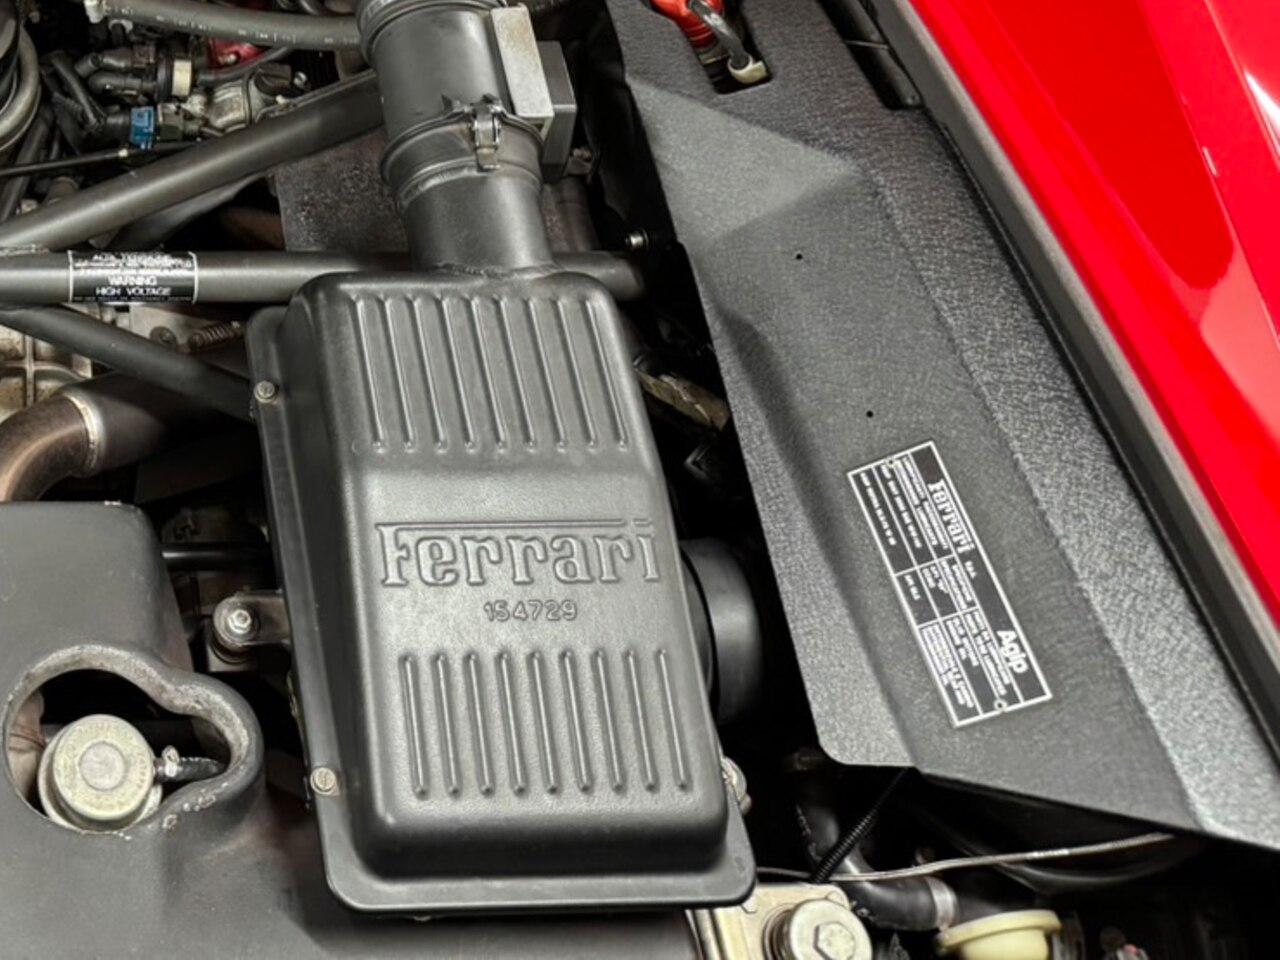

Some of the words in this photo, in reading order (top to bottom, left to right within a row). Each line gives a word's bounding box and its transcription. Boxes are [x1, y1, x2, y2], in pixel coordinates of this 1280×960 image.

[95, 287, 121, 296] HIGH
[126, 286, 171, 296] VOLTAGE
[107, 275, 158, 286] WARNING
[927, 478, 976, 555] Ferrari
[374, 518, 661, 588] Ferrari
[483, 599, 578, 623] 154729
[996, 629, 1029, 674] Agip
